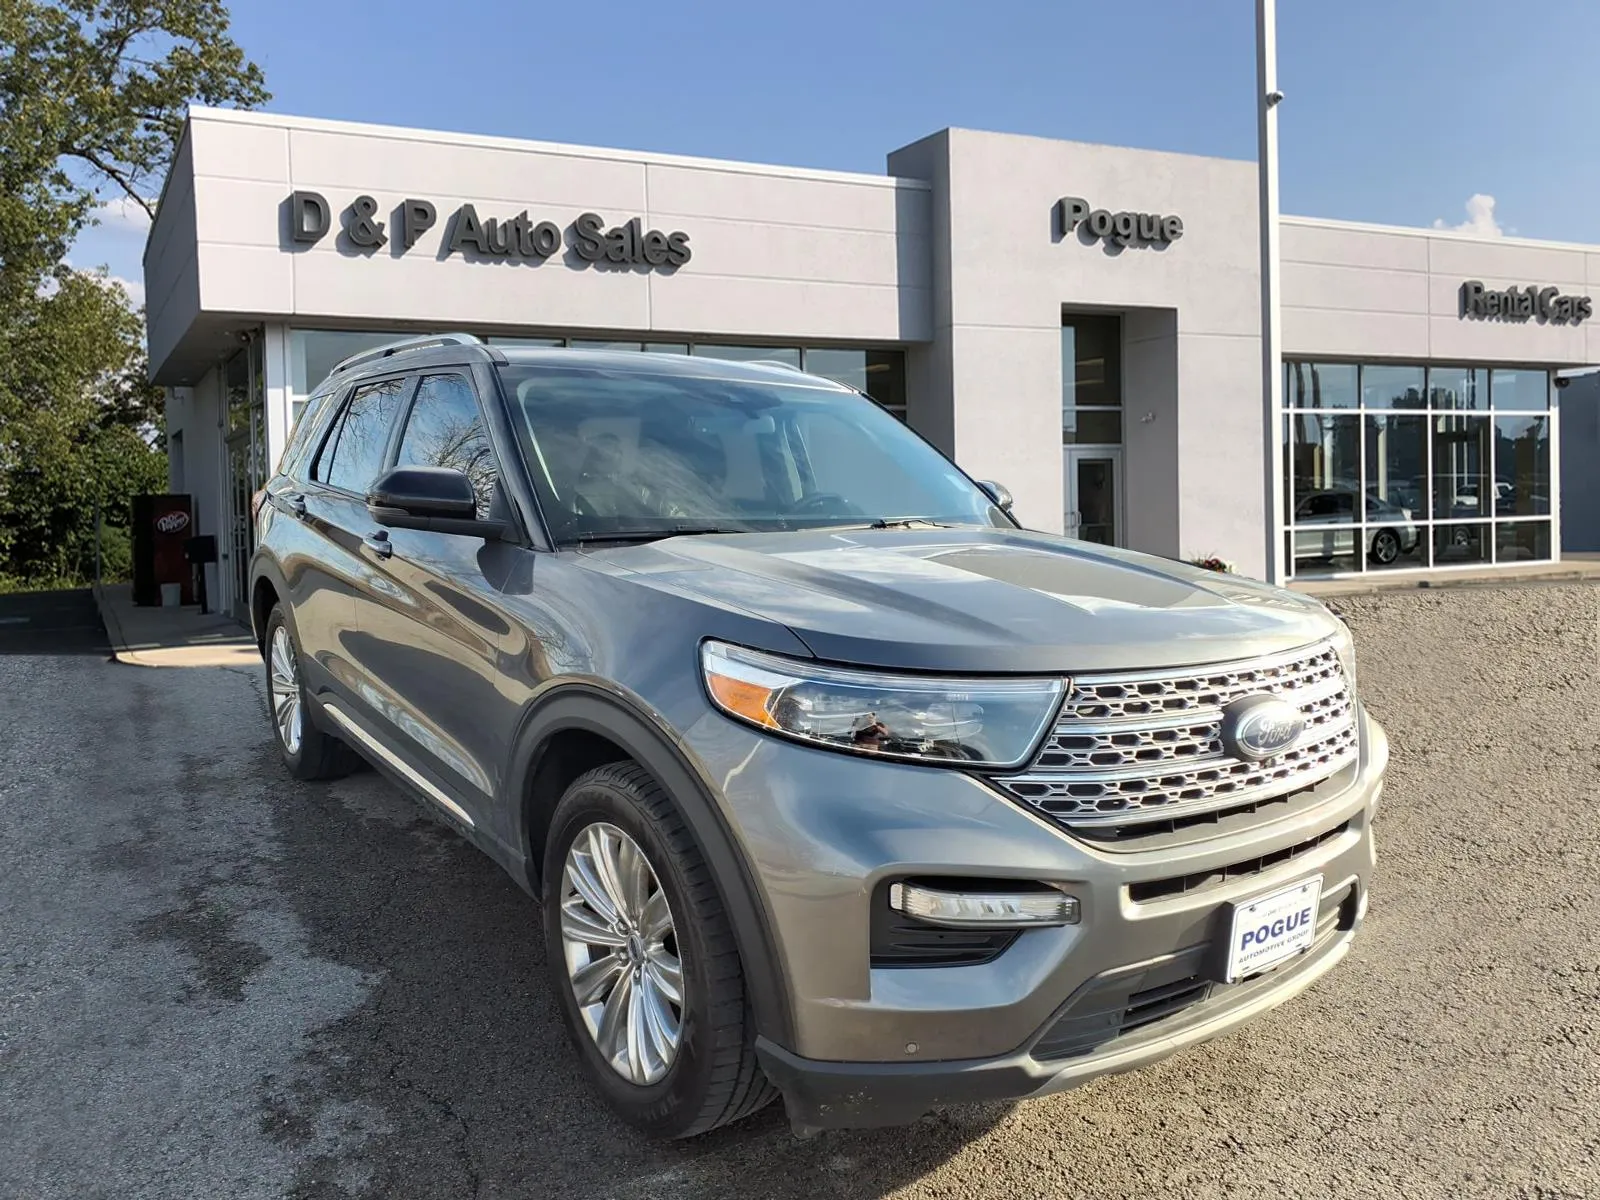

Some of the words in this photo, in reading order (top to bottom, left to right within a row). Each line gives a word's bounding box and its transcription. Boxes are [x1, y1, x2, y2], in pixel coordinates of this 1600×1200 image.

[285, 190, 331, 247] D
[339, 195, 388, 252] &
[396, 198, 437, 249] P
[446, 203, 562, 261] Auto
[570, 212, 692, 269] Sales
[1053, 196, 1184, 250] Pogue
[1460, 280, 1538, 321] Rental
[1538, 286, 1593, 324] Cars
[1257, 718, 1295, 746] Ford
[1238, 940, 1285, 964] AUTOMOTIVE
[1287, 929, 1309, 945] GROUP
[1241, 906, 1311, 951] POGUE
